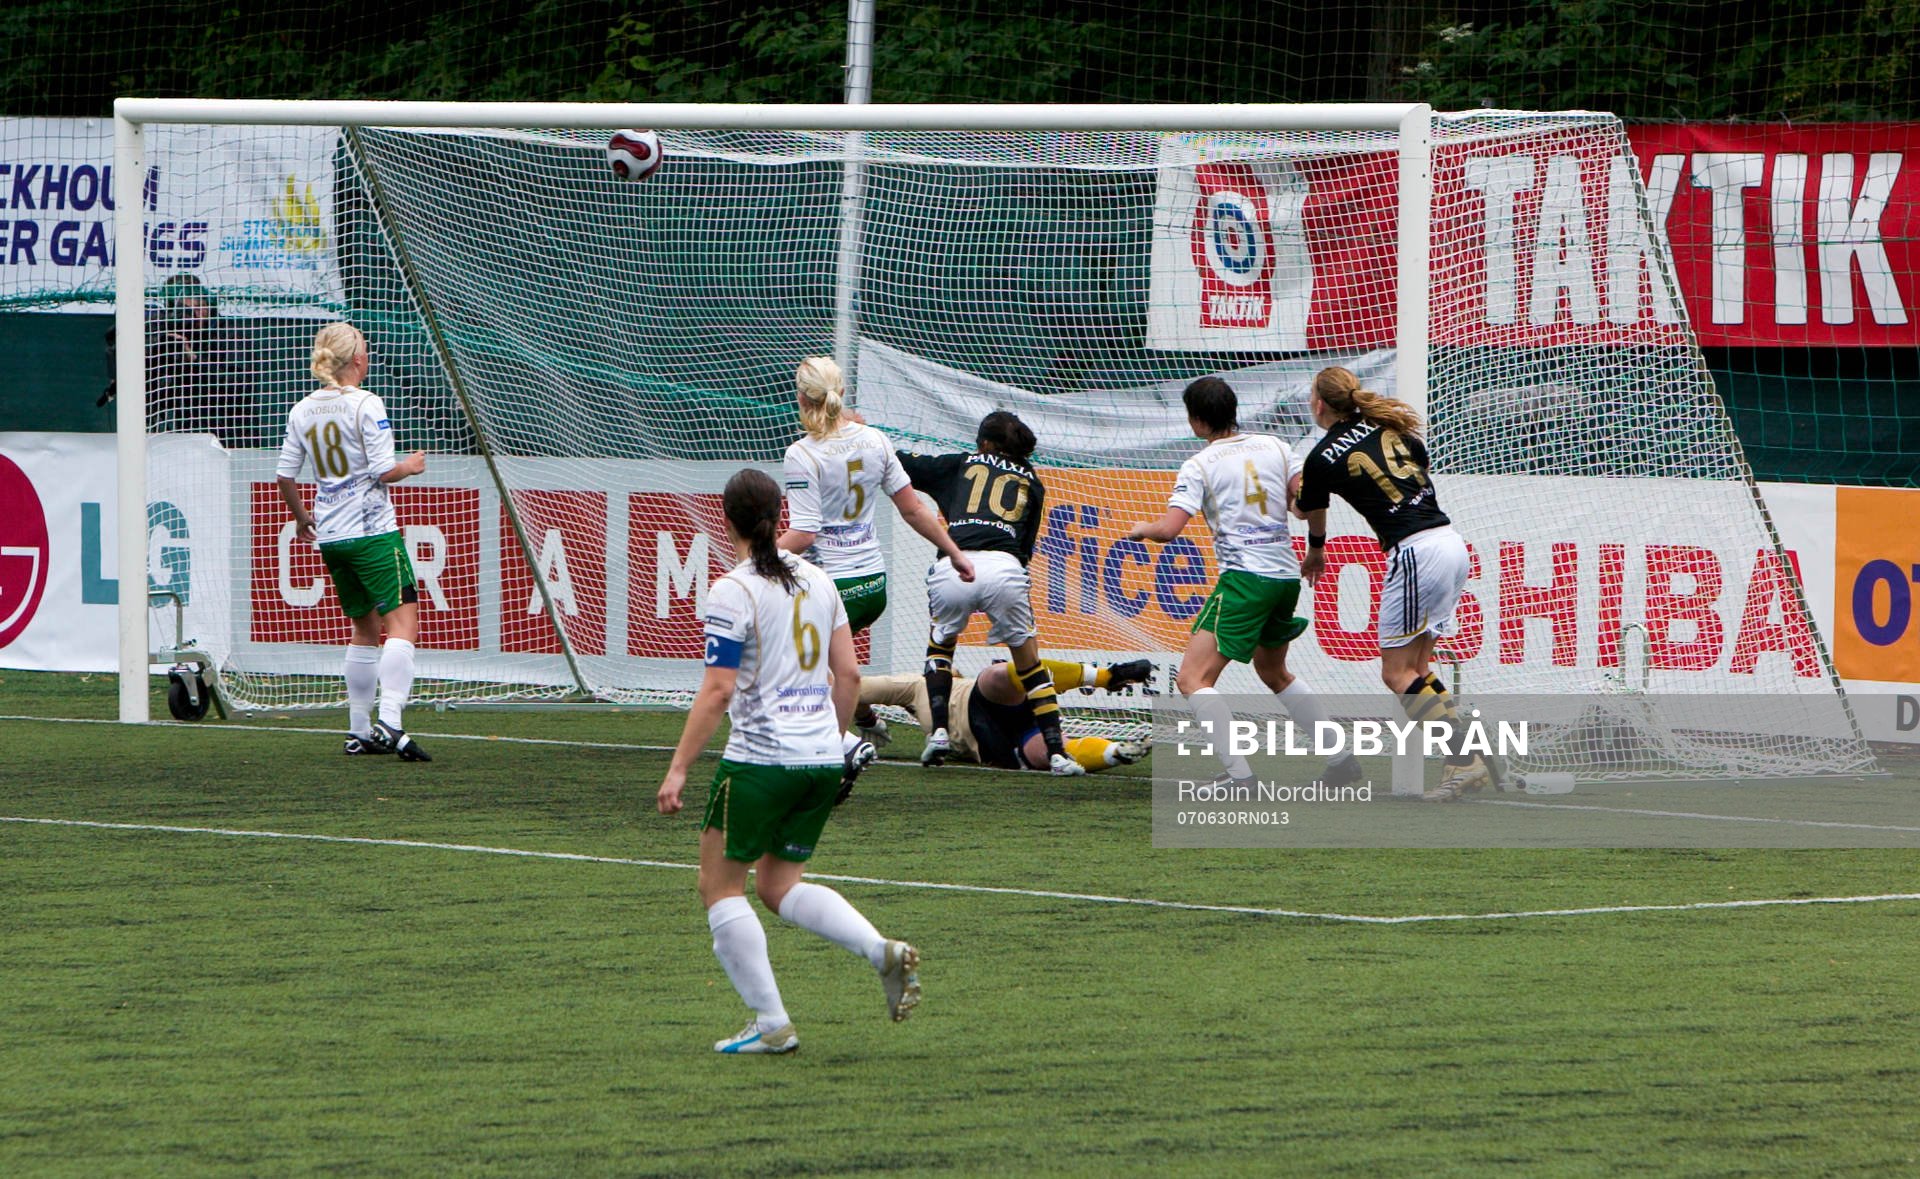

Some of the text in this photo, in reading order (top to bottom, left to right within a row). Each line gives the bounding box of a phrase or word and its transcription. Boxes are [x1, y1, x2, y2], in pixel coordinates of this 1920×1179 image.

[50, 221, 208, 268] GAES
[1465, 153, 1908, 326] TAKTIK
[305, 421, 349, 478] 18
[965, 453, 1034, 480] PANAXIA
[1347, 428, 1427, 504] 14
[844, 458, 865, 521] 5
[964, 464, 1030, 522] 10
[1244, 459, 1268, 516] 4
[81, 501, 191, 608] LG
[1033, 503, 1208, 620] fice
[793, 590, 821, 672] 6
[1291, 535, 1823, 678] OHIBA
[705, 636, 719, 664] C
